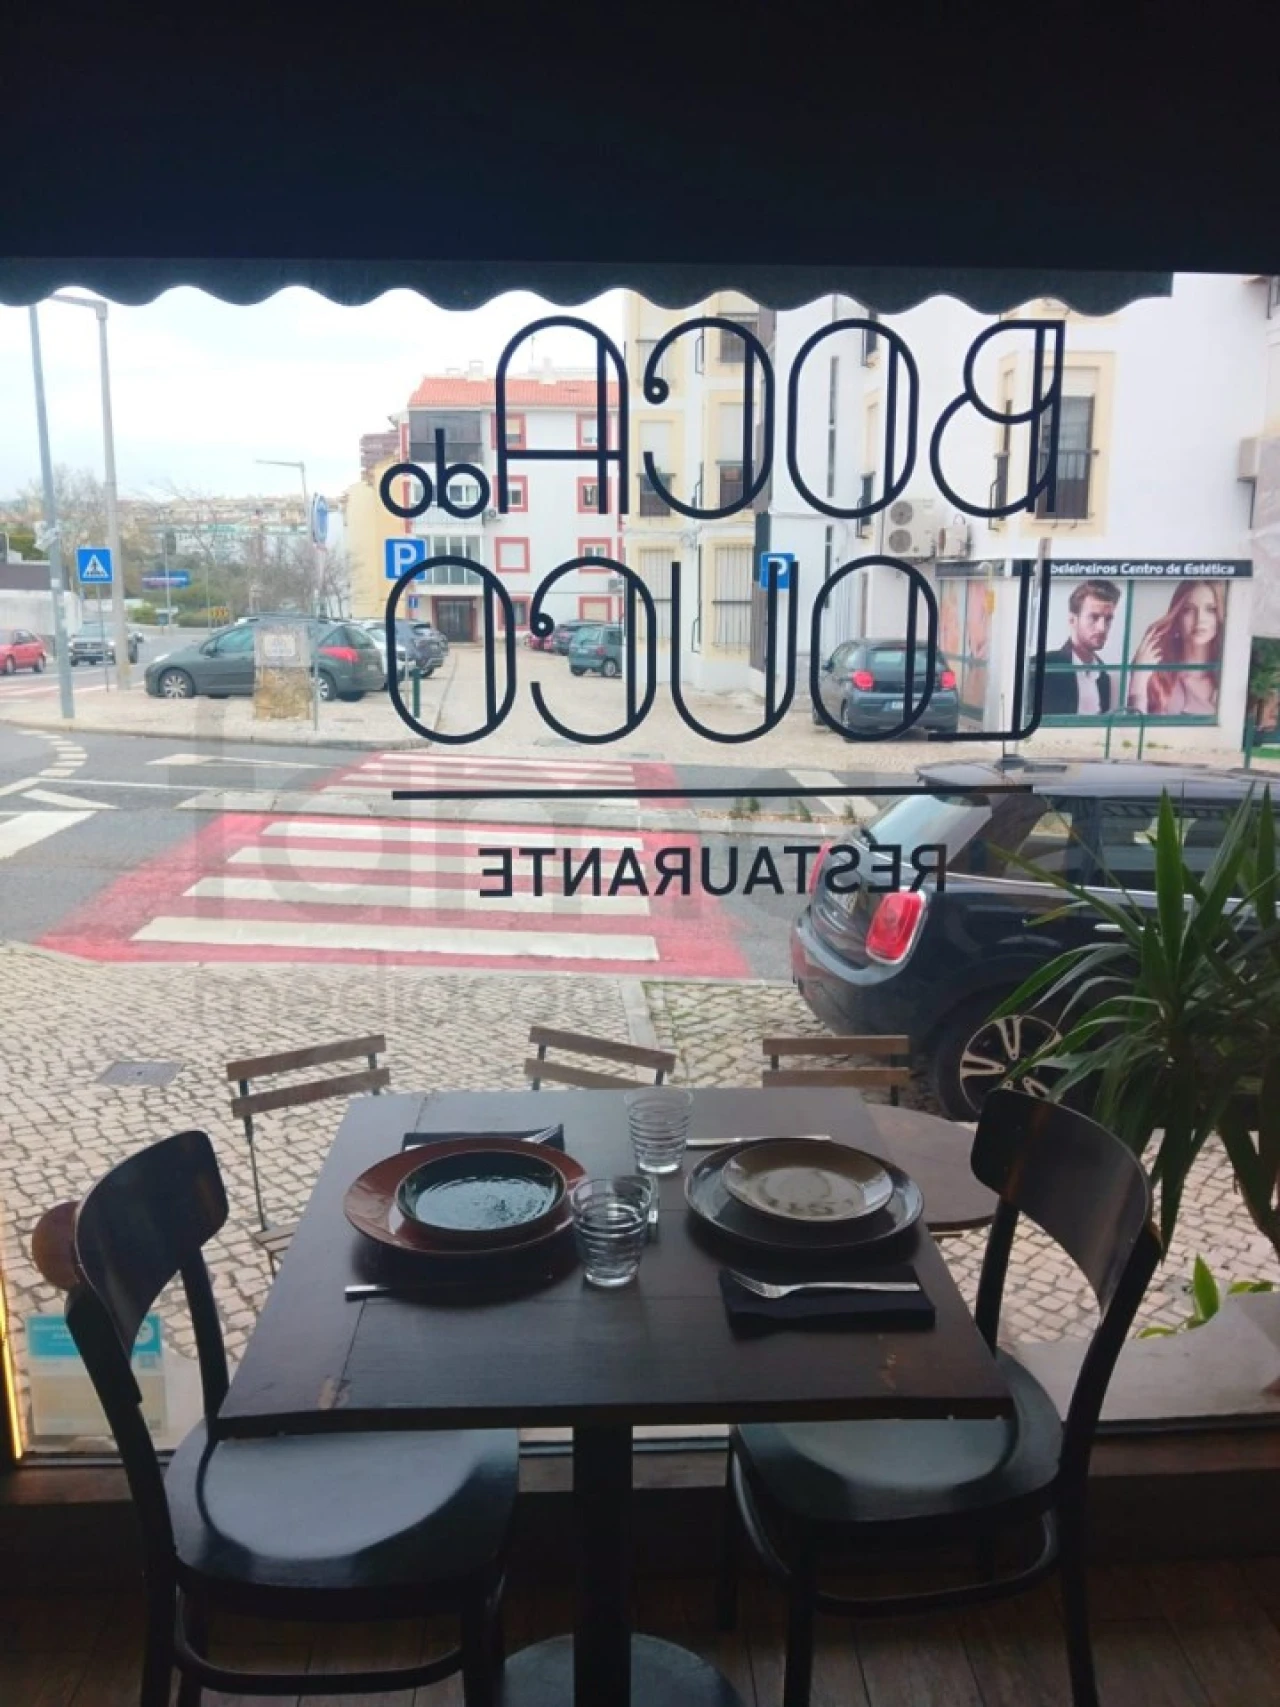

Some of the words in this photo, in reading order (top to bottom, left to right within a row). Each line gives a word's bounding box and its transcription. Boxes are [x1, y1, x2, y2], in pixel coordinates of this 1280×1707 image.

[393, 542, 418, 577] P
[1034, 562, 1118, 576] beleireiros
[1120, 562, 1164, 576] Centro
[1165, 562, 1181, 576] de
[1183, 560, 1236, 576] Estética
